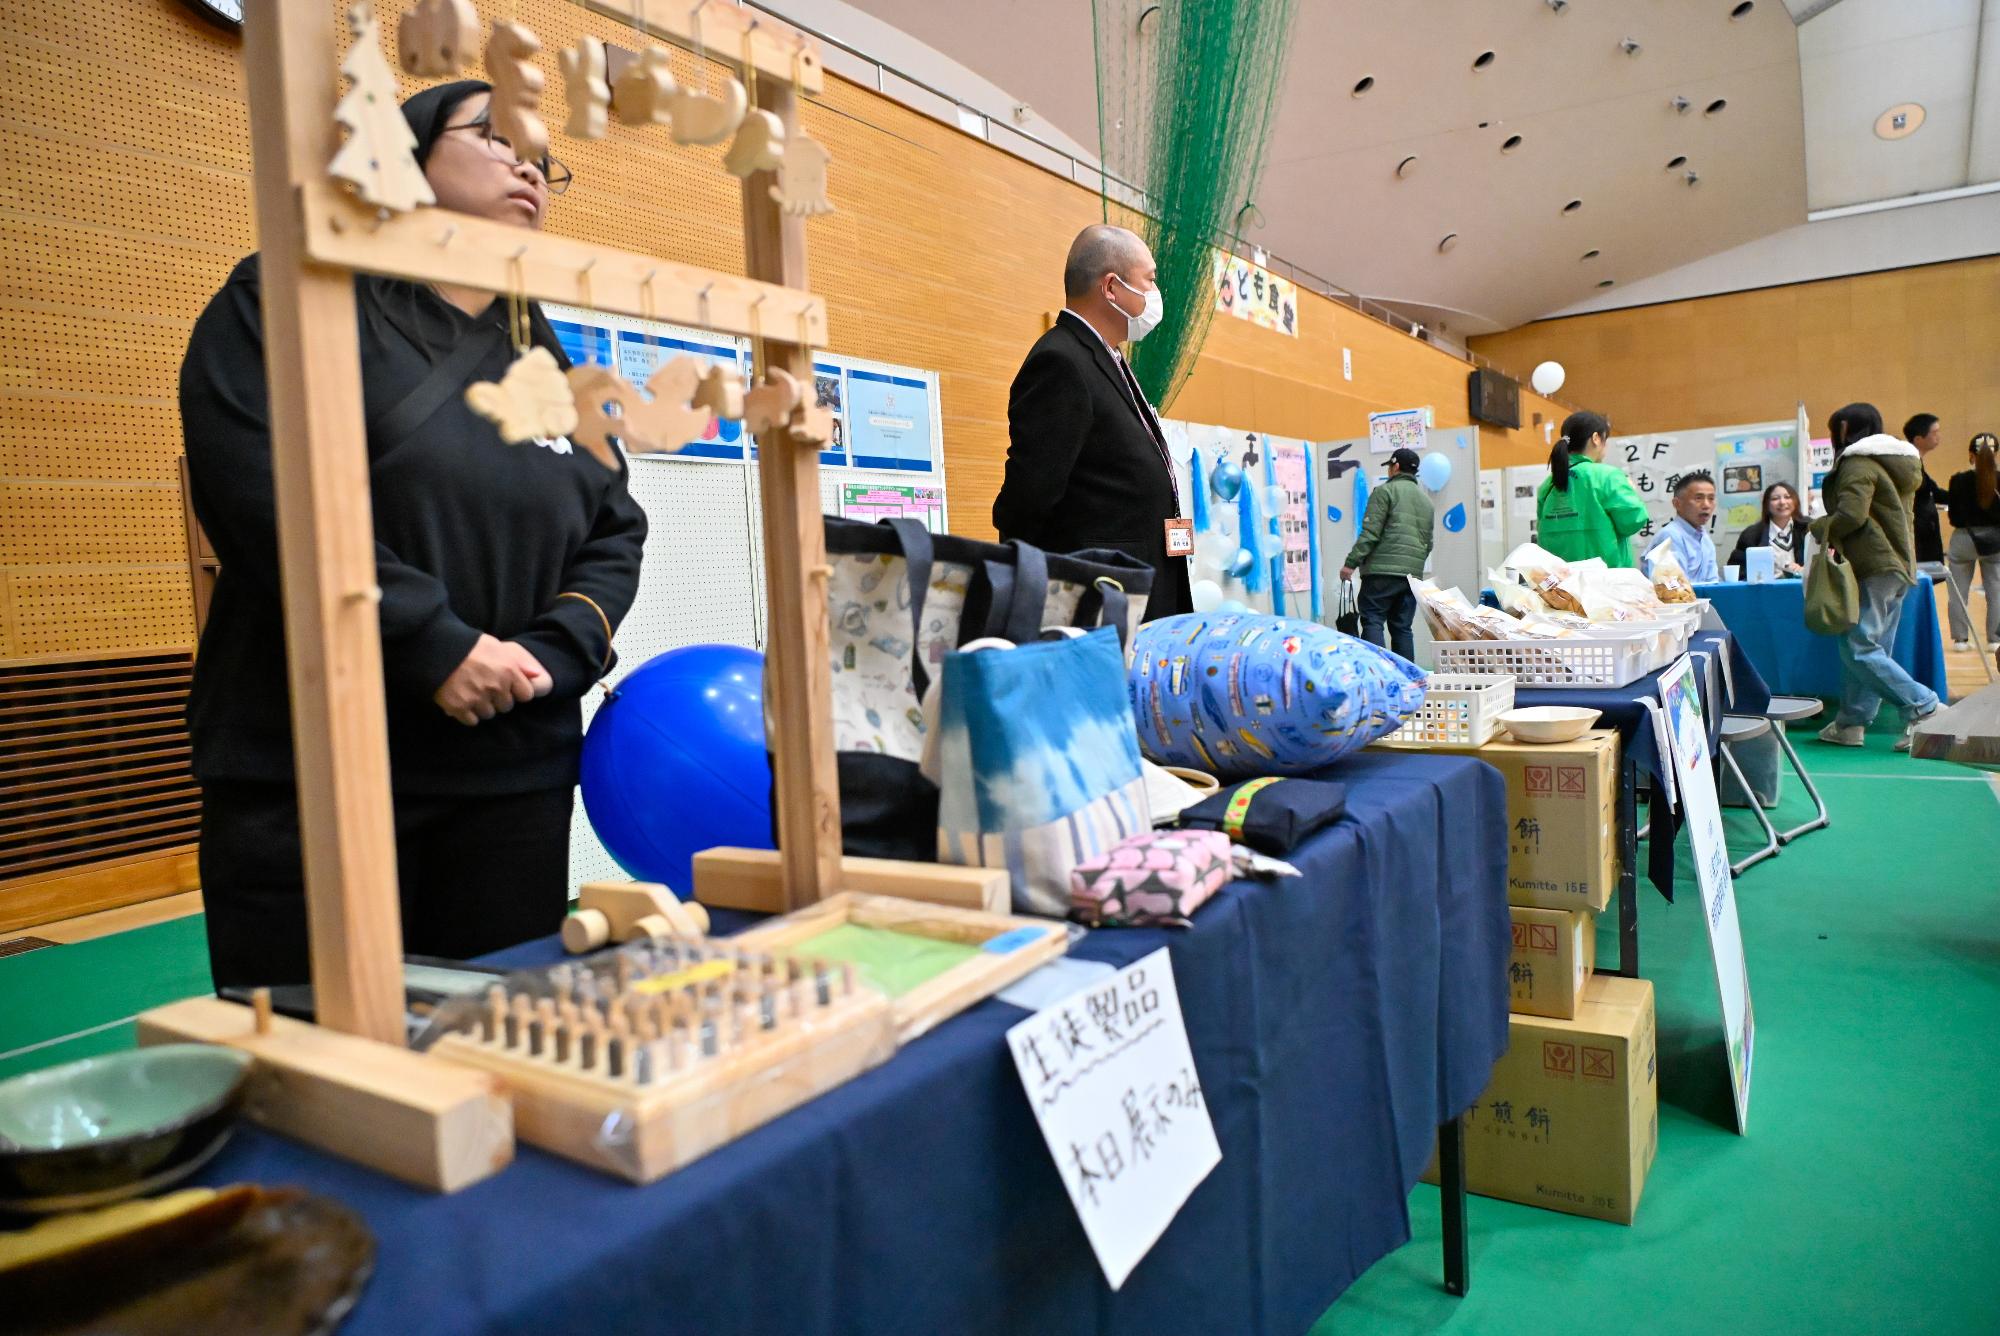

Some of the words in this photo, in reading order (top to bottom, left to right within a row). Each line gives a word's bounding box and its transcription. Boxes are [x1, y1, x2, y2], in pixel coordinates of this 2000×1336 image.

[1509, 878, 1558, 893] Kumitte
[1022, 969, 1160, 1082] 生徒製品
